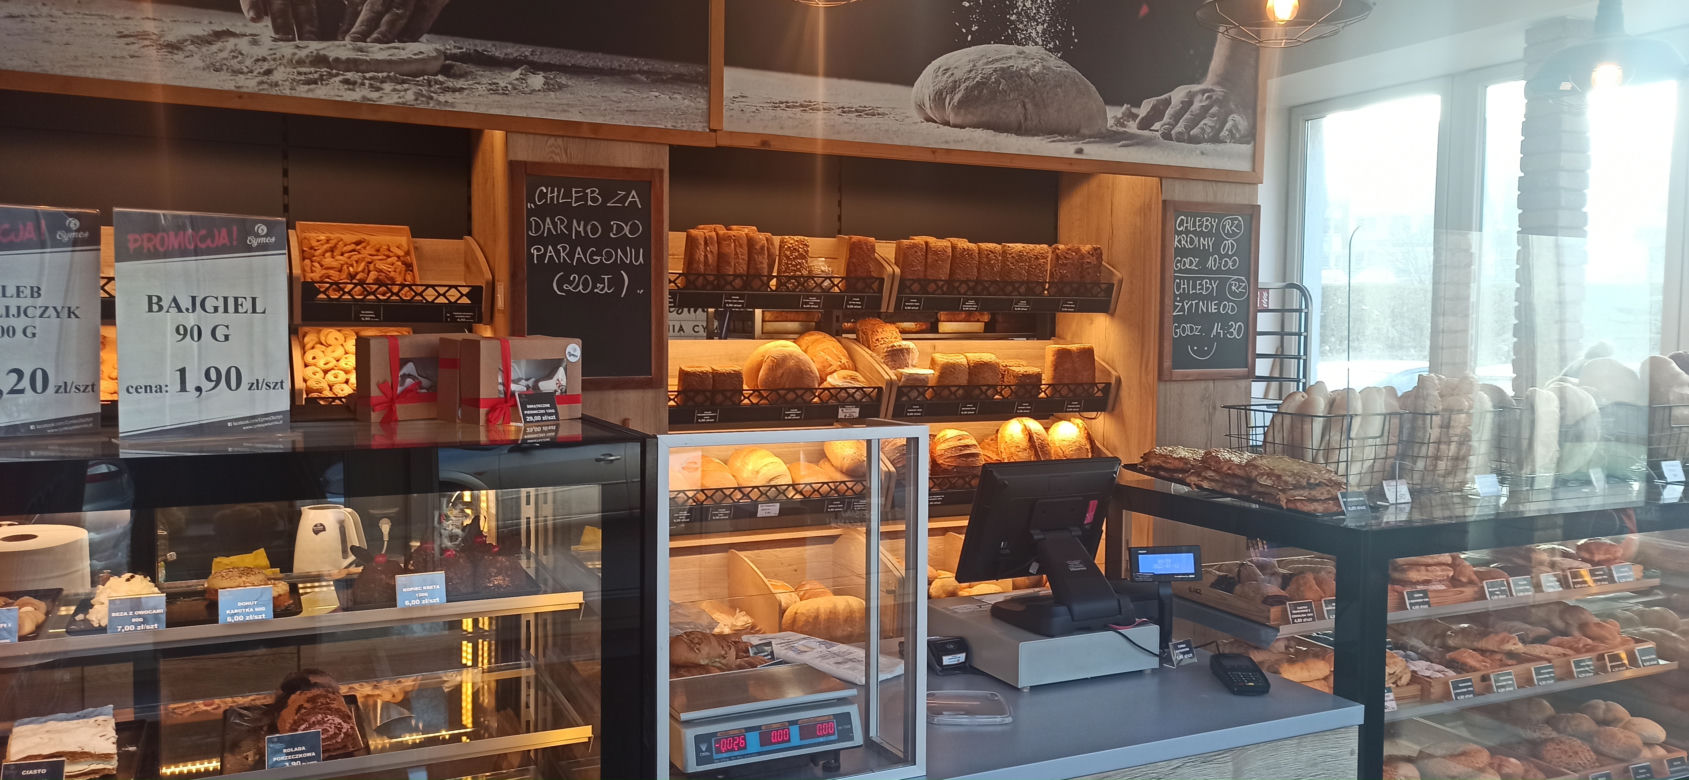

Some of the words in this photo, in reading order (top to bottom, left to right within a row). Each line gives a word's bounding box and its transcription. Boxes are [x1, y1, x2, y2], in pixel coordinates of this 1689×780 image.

[606, 190, 642, 208] ZA
[528, 215, 602, 239] DARMO
[609, 220, 642, 238] DO
[1176, 216, 1218, 233] CHLEBY
[1223, 219, 1240, 234] RZ
[127, 225, 238, 253] PROMOCJA!
[1174, 234, 1215, 252] KROIMY
[1220, 239, 1237, 255] OD
[530, 243, 644, 266] PARAGONU
[1173, 256, 1202, 270] GODZ.
[1206, 255, 1239, 270] 10:00
[1, 285, 42, 299] LEB
[1174, 280, 1219, 296] CHLEBY
[1230, 281, 1247, 293] RZ
[145, 294, 266, 315] BAJGIEL
[1172, 297, 1218, 316] ŻYTNIE
[1219, 302, 1238, 315] OD
[22, 325, 37, 339] G
[174, 324, 202, 343] 90
[210, 324, 231, 343] G
[668, 324, 685, 333] IA
[1172, 323, 1206, 338] GODZ.
[1210, 322, 1245, 339] 14:30
[53, 381, 96, 395] zł/szt
[125, 383, 169, 395] cena:
[175, 365, 243, 399] 1,90
[247, 378, 285, 391] zł/szt
[21, 768, 47, 776] CIASTO
